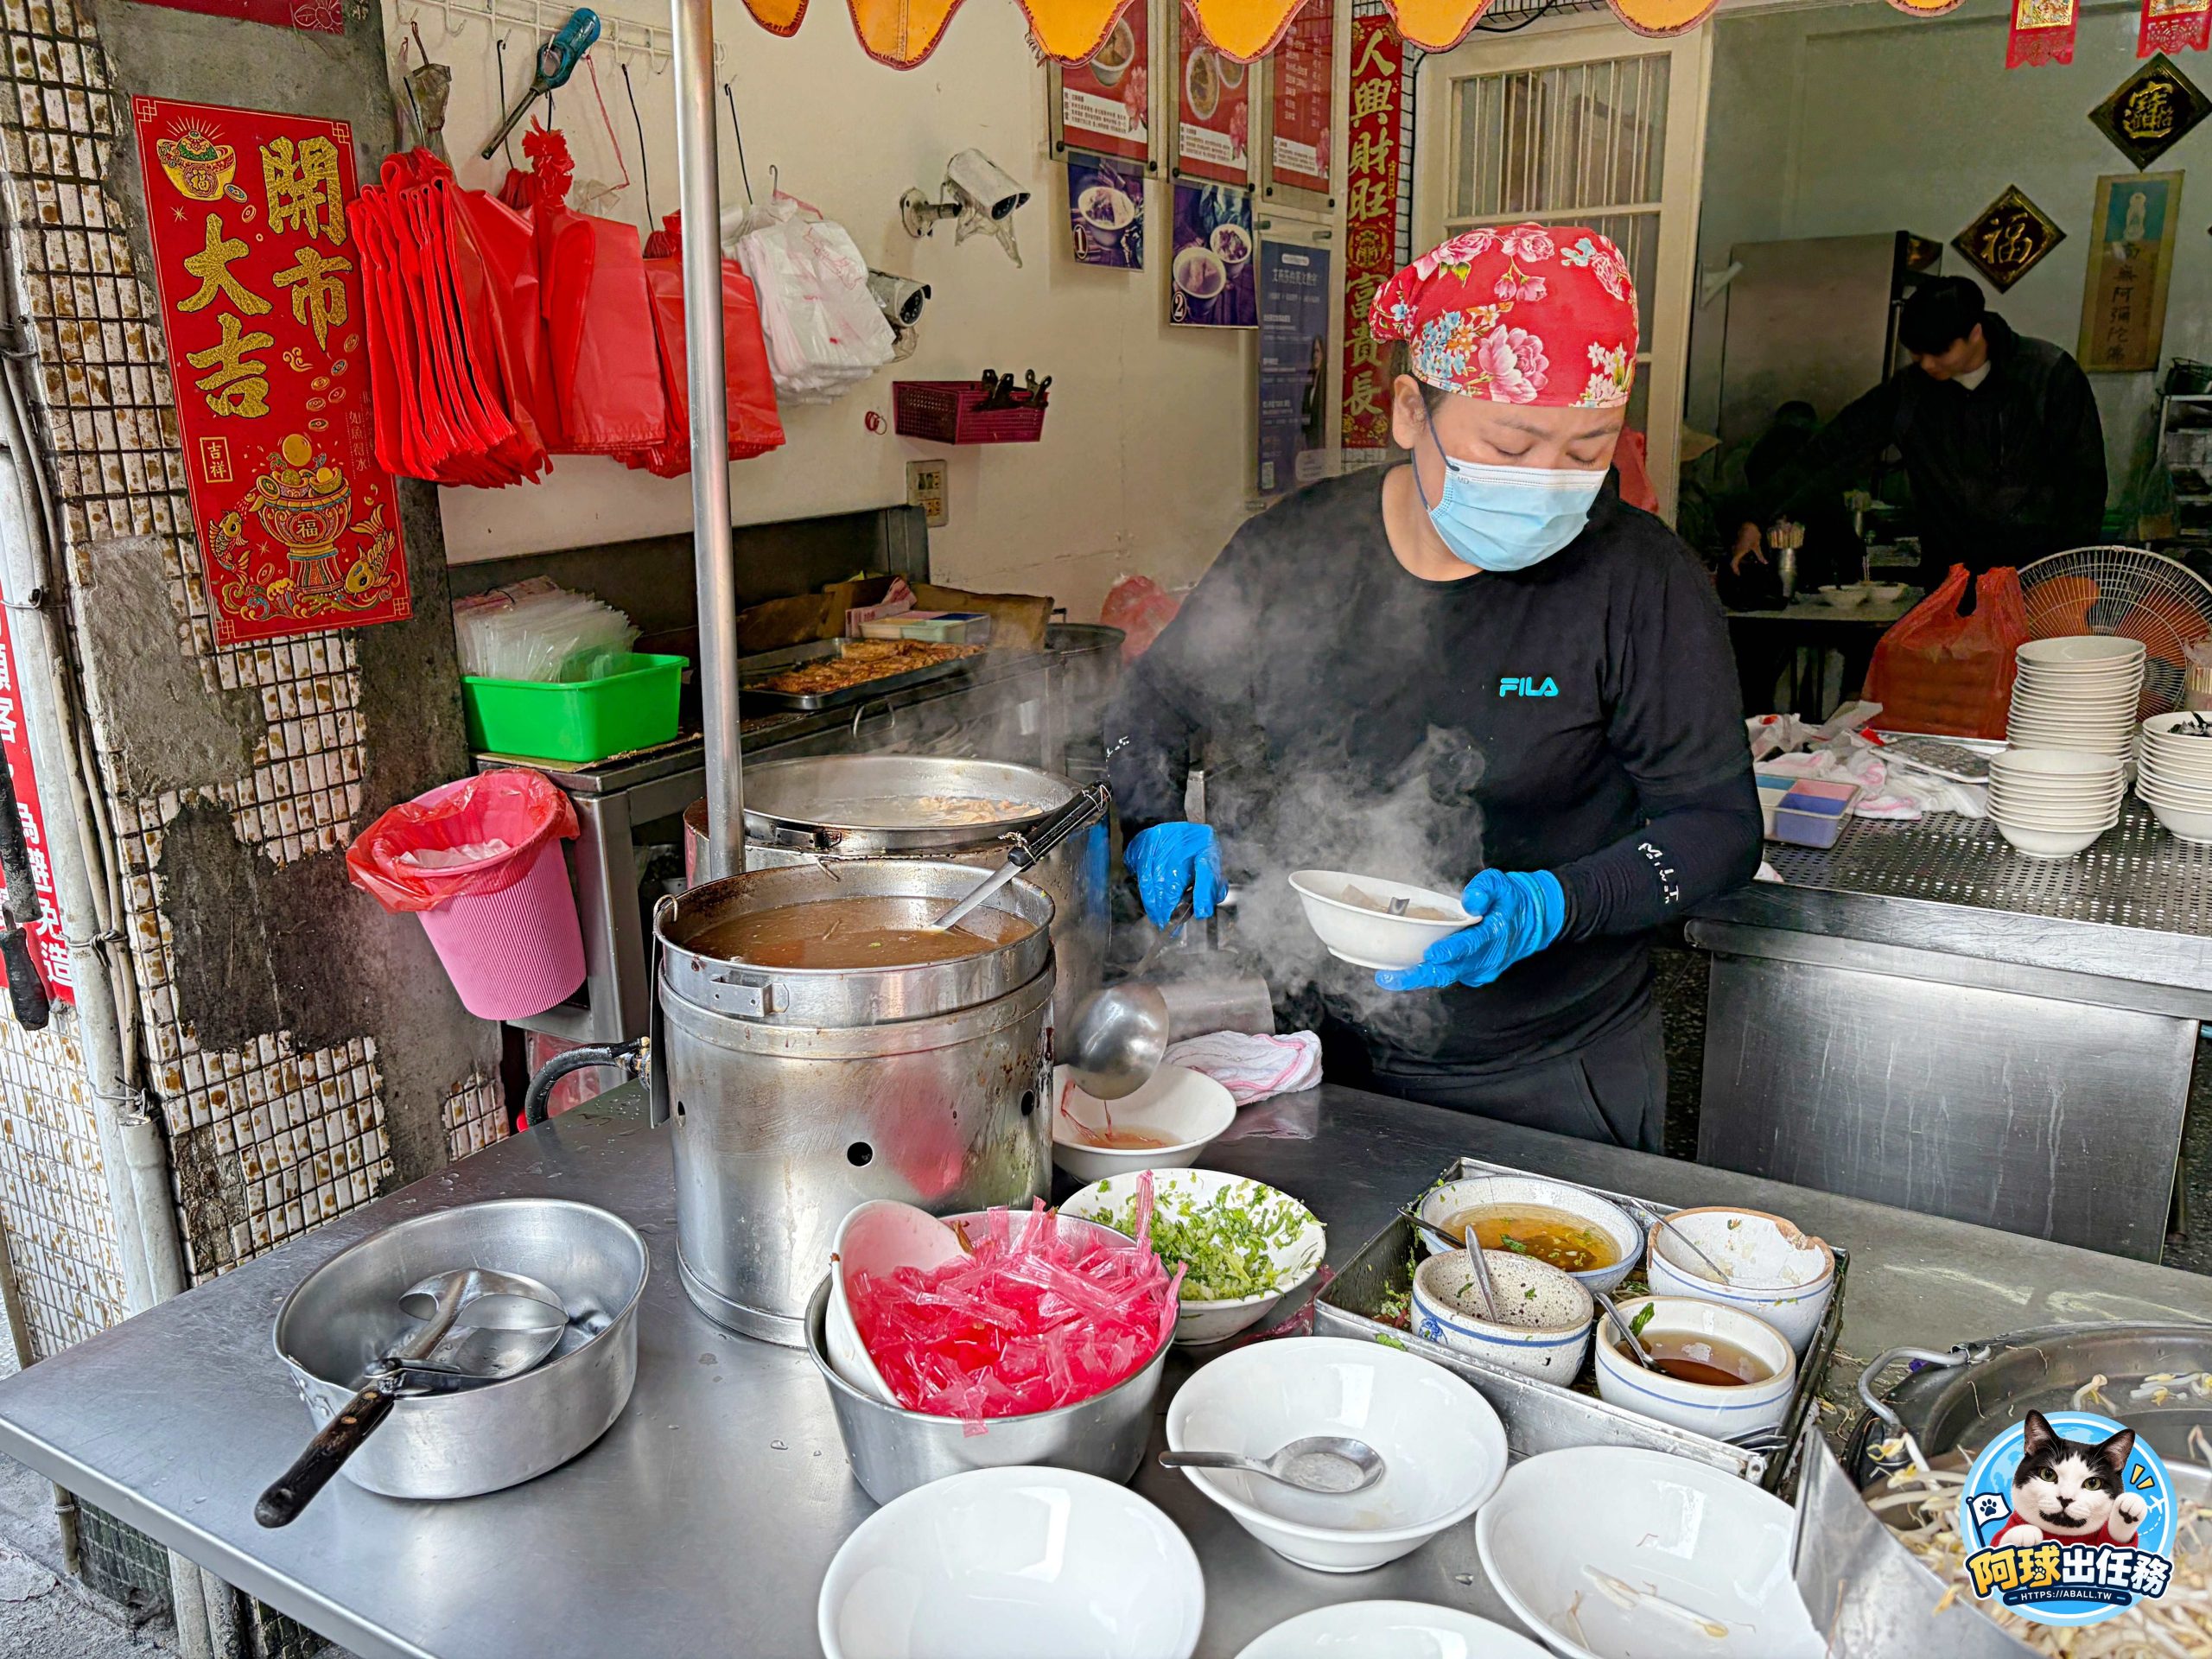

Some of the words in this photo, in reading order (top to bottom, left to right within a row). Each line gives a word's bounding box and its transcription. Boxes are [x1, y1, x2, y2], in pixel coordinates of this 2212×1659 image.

[258, 136, 353, 353] 開市
[1075, 227, 1085, 255] 1
[1980, 212, 2033, 264] 福
[176, 213, 275, 418] 大吉
[1173, 293, 1185, 318] 2
[207, 442, 227, 479] 吉祥
[296, 518, 319, 538] 福
[1498, 677, 1560, 697] FILA
